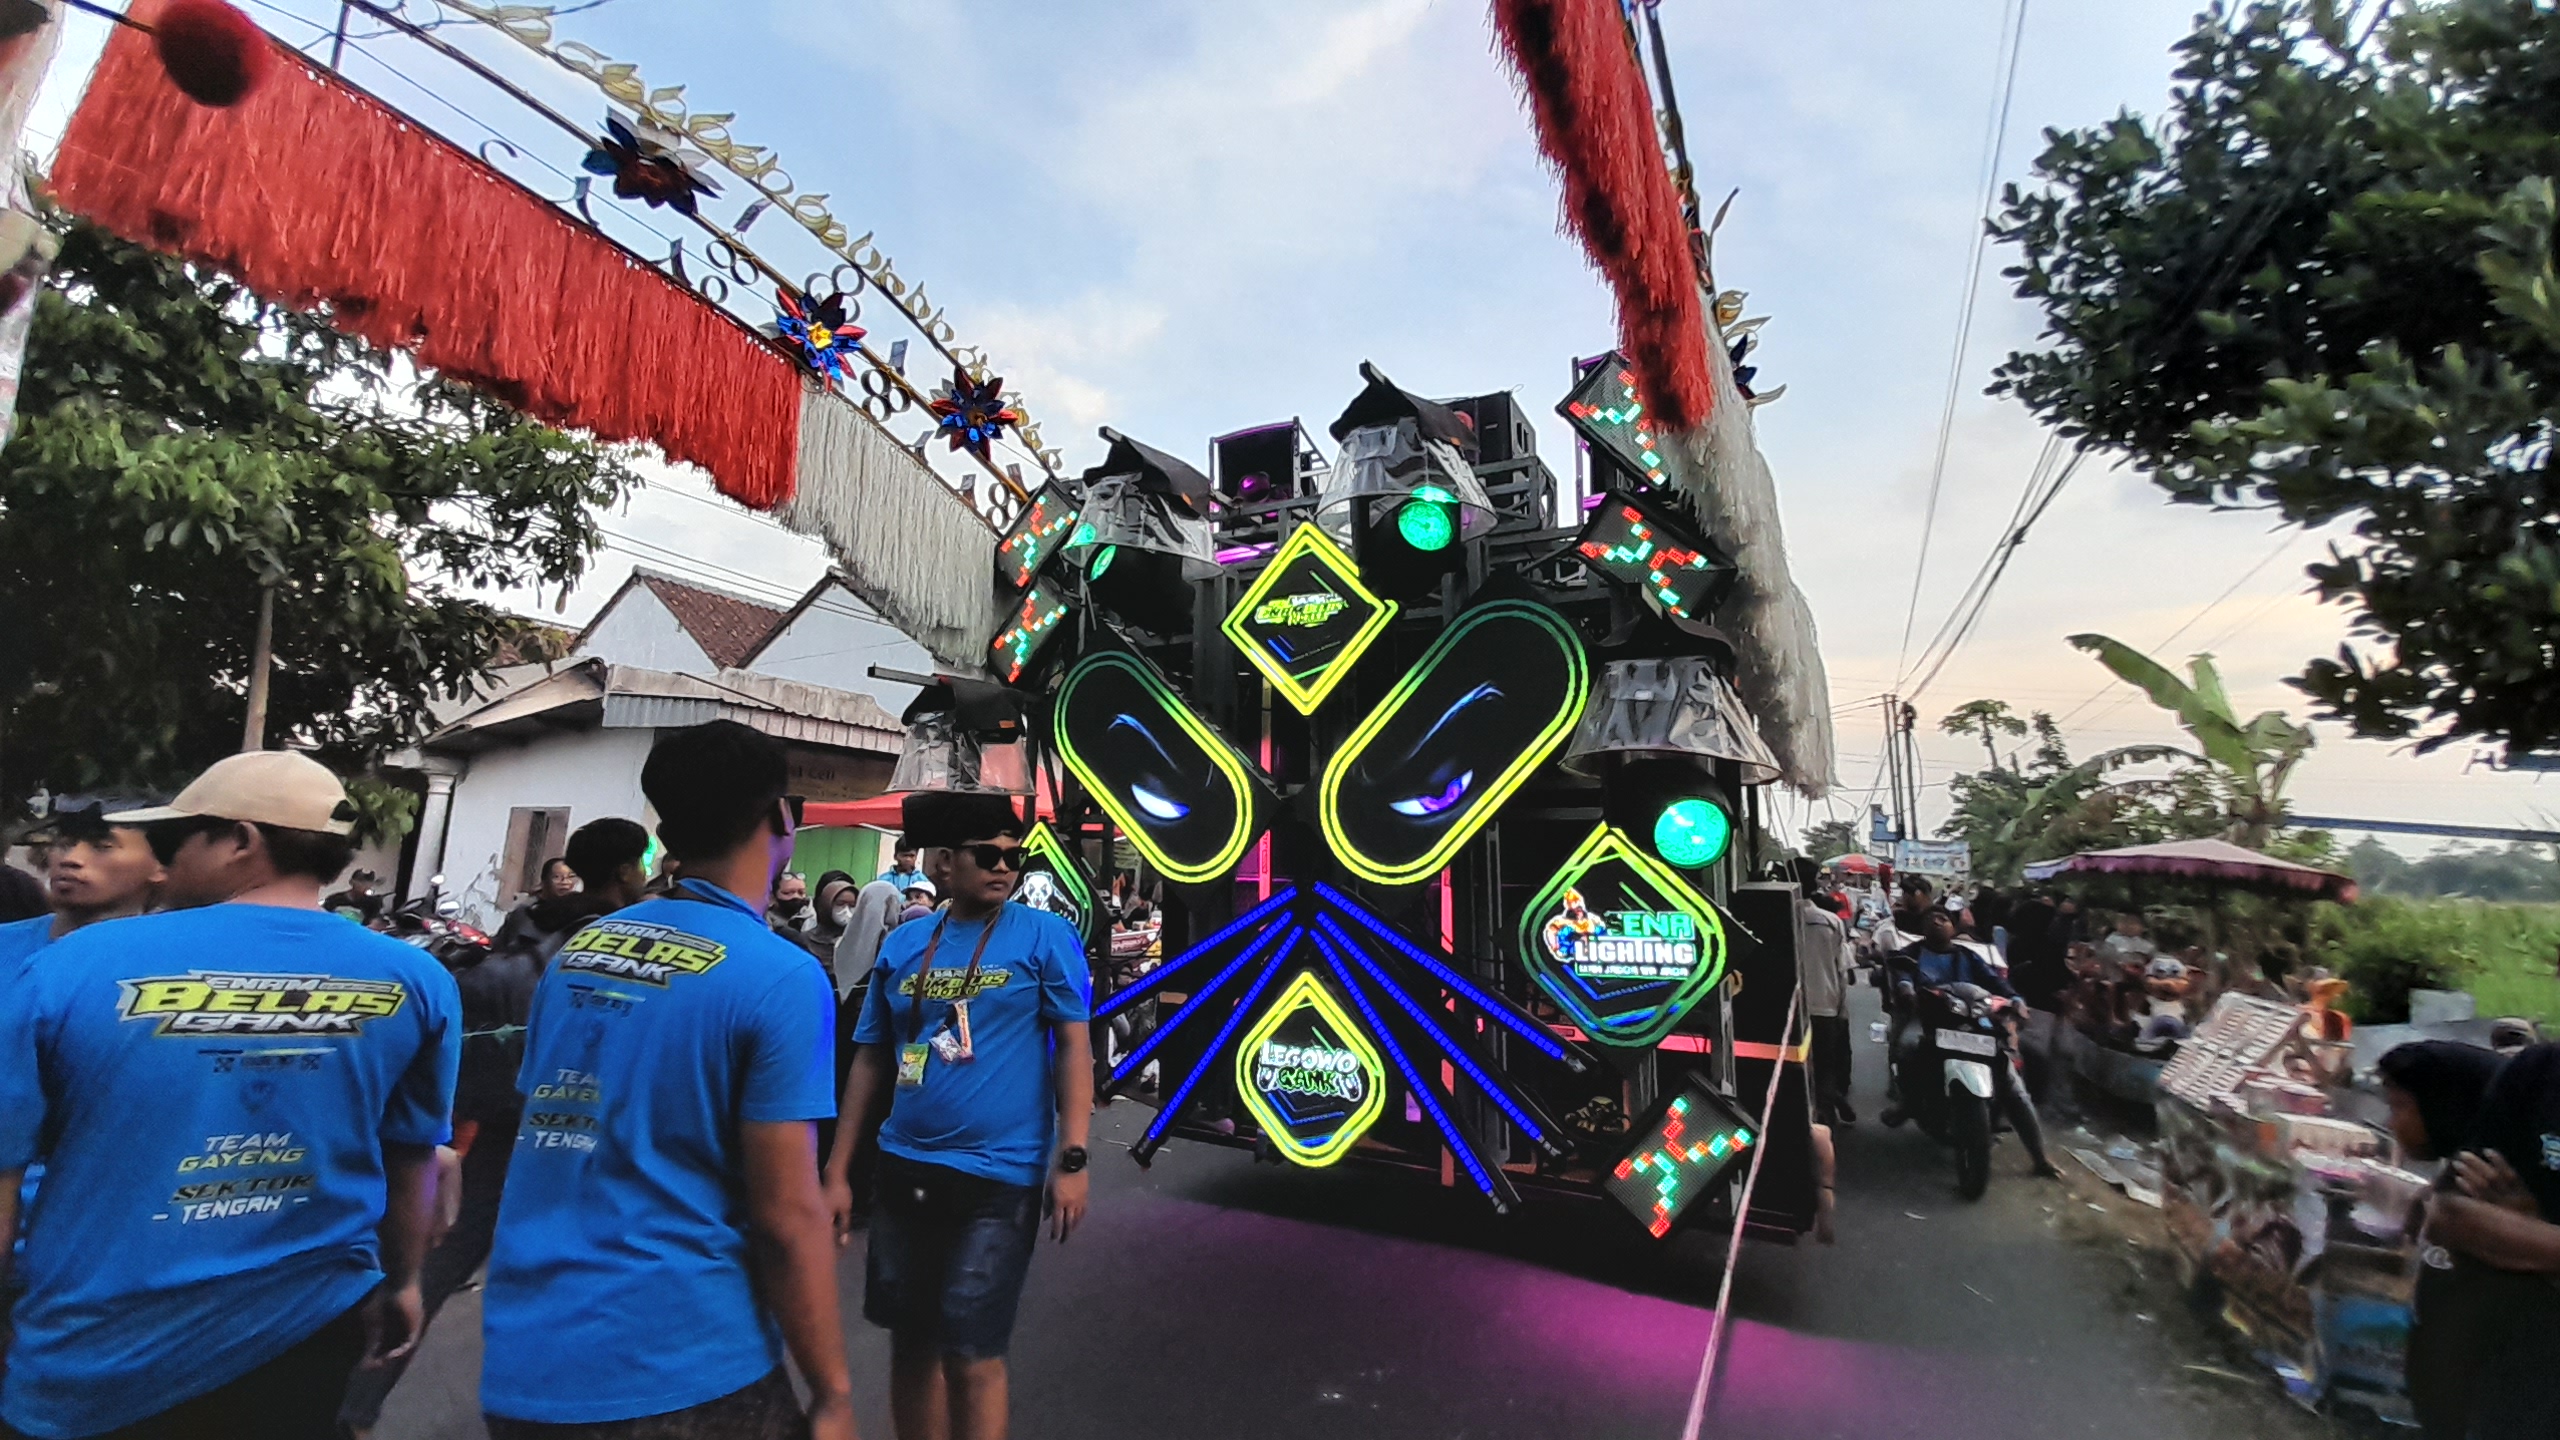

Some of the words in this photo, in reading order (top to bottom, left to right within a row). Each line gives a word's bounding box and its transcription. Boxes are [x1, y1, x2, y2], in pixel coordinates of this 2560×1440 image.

[600, 921, 668, 940] ENAM
[564, 927, 720, 973] BELAS
[566, 950, 677, 980] GANK
[132, 981, 402, 1013] BELAS
[205, 976, 321, 992] ENAM
[172, 1012, 355, 1032] GANK
[1259, 1038, 1360, 1074] LEGOWO
[557, 1068, 599, 1087] TEA
[205, 1132, 292, 1152] TEAM
[177, 1148, 306, 1173] GAYENG
[172, 1174, 316, 1203] SEKTOR
[182, 1196, 283, 1225] TENGAH
